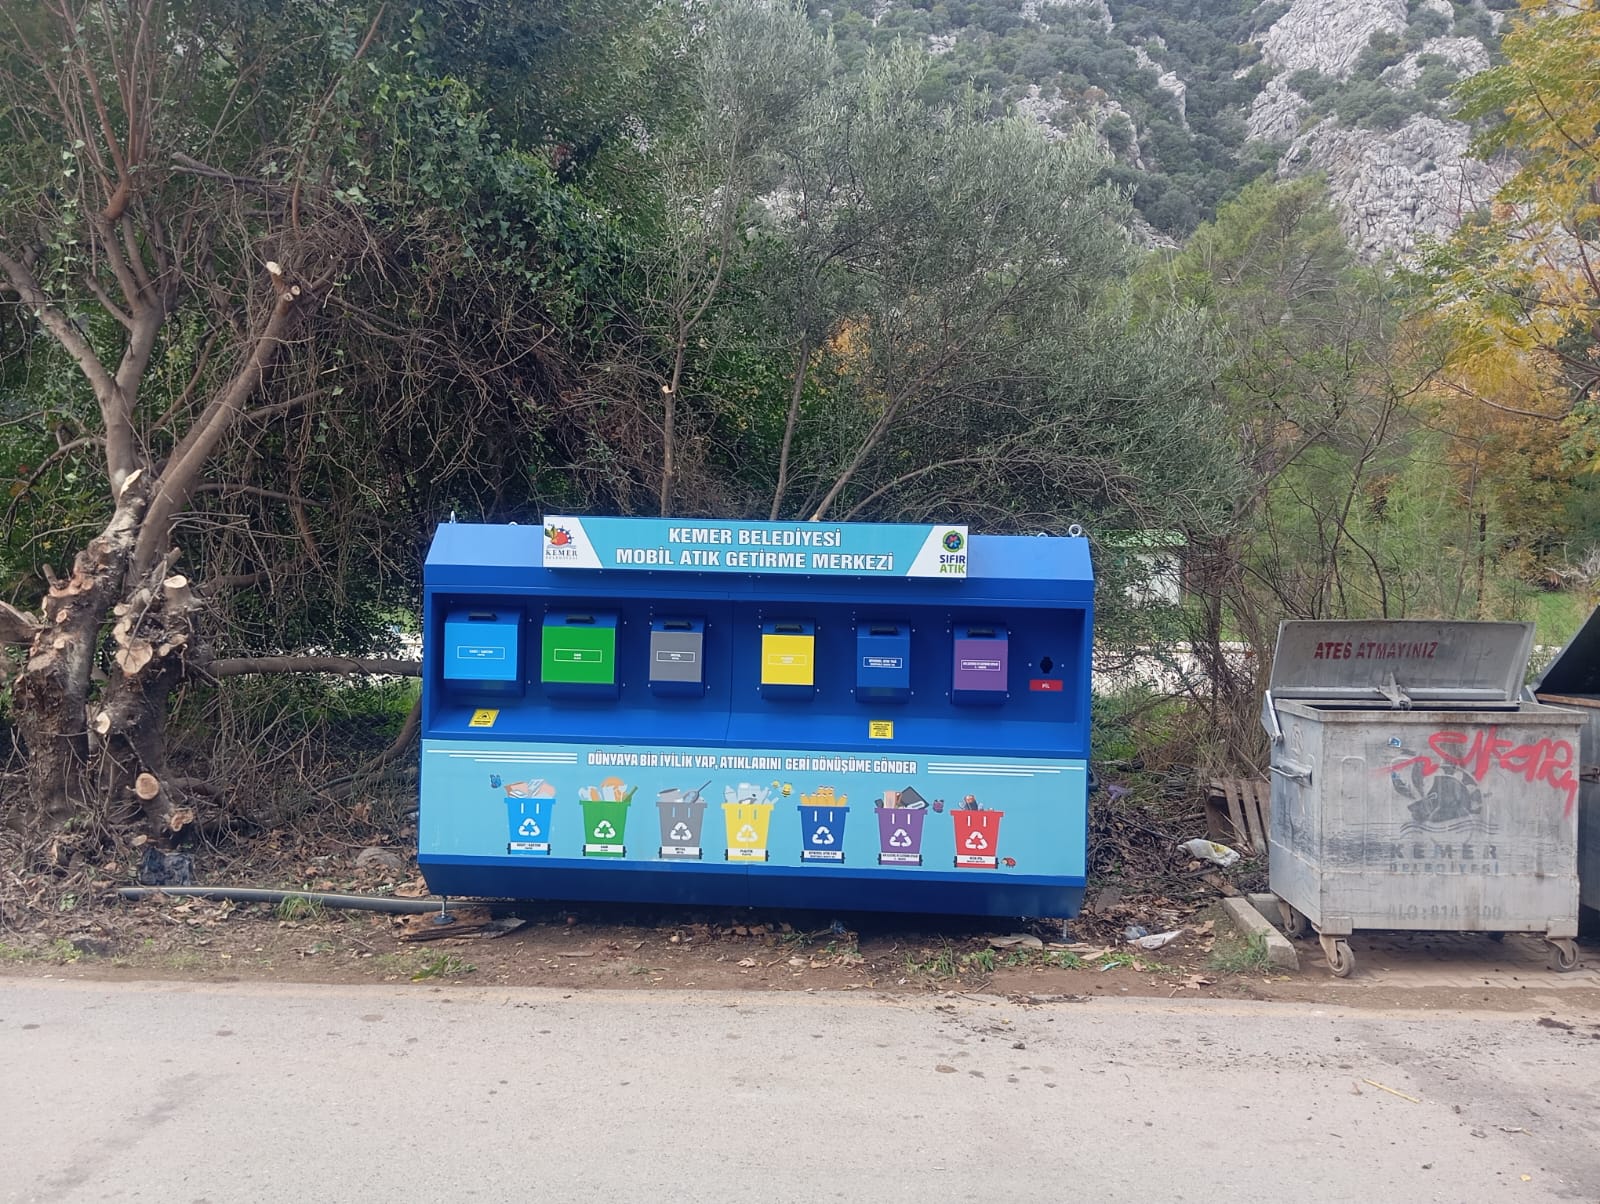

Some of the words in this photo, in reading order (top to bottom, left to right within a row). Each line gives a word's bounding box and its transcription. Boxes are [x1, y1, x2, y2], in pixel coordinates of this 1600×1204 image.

[669, 527, 732, 545] KEMER
[738, 527, 841, 547] BELEDİYESİ
[616, 547, 674, 565] MOBİL
[679, 550, 720, 567] ATIK
[725, 549, 806, 569] GETİRME
[812, 552, 893, 571] MERKEZİ
[939, 554, 966, 564] SIFIR
[939, 564, 965, 574] ATIK
[1356, 642, 1438, 659] ATMAYINIZ
[588, 750, 638, 766] DÜNYAYA
[640, 752, 658, 767] BİR
[660, 752, 693, 768] İYİLİK
[694, 755, 719, 770] YAP,
[719, 756, 782, 770] ATIKLARINI
[785, 755, 810, 771] GERİ
[812, 756, 872, 774] DÖNÜŞÜME
[873, 758, 918, 774] GÖNDER
[1391, 843, 1497, 859] KEMER
